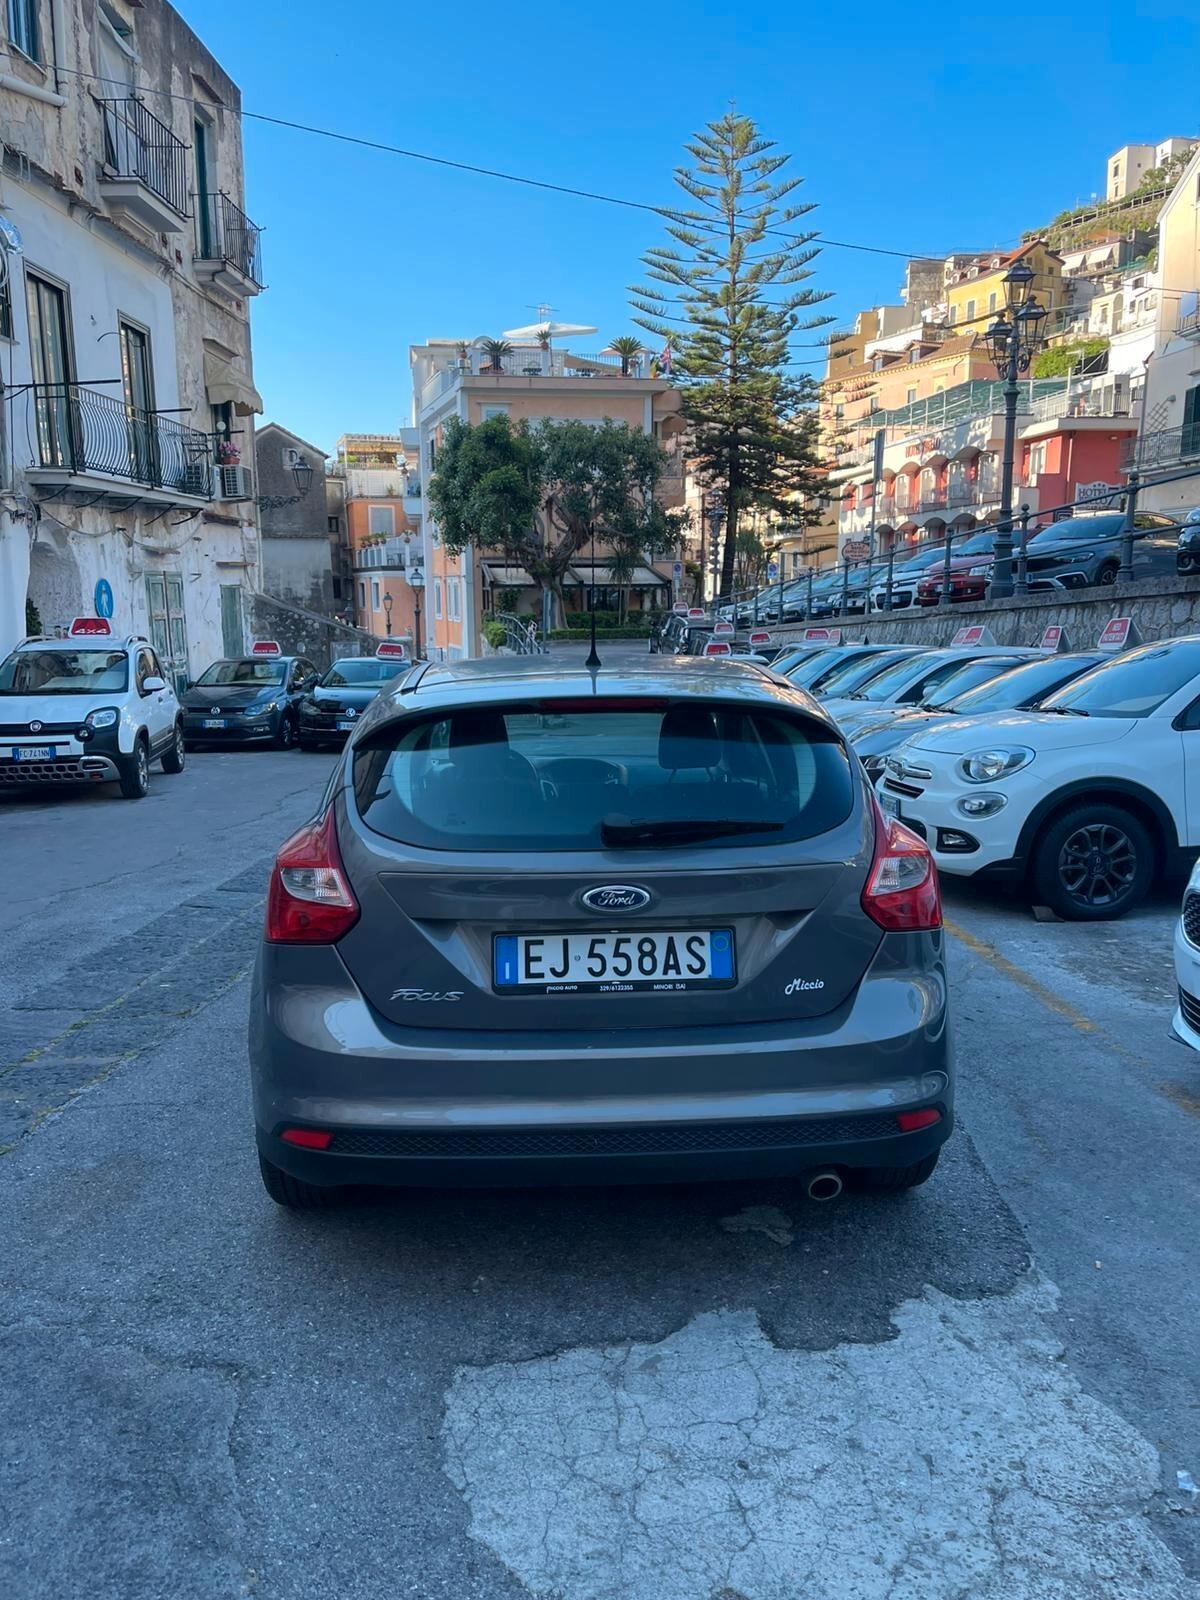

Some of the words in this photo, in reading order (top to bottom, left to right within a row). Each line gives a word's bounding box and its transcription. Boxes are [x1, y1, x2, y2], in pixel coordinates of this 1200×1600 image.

[1079, 488, 1106, 497] HOTEL
[598, 890, 635, 905] Ford
[784, 978, 825, 995] Miccio
